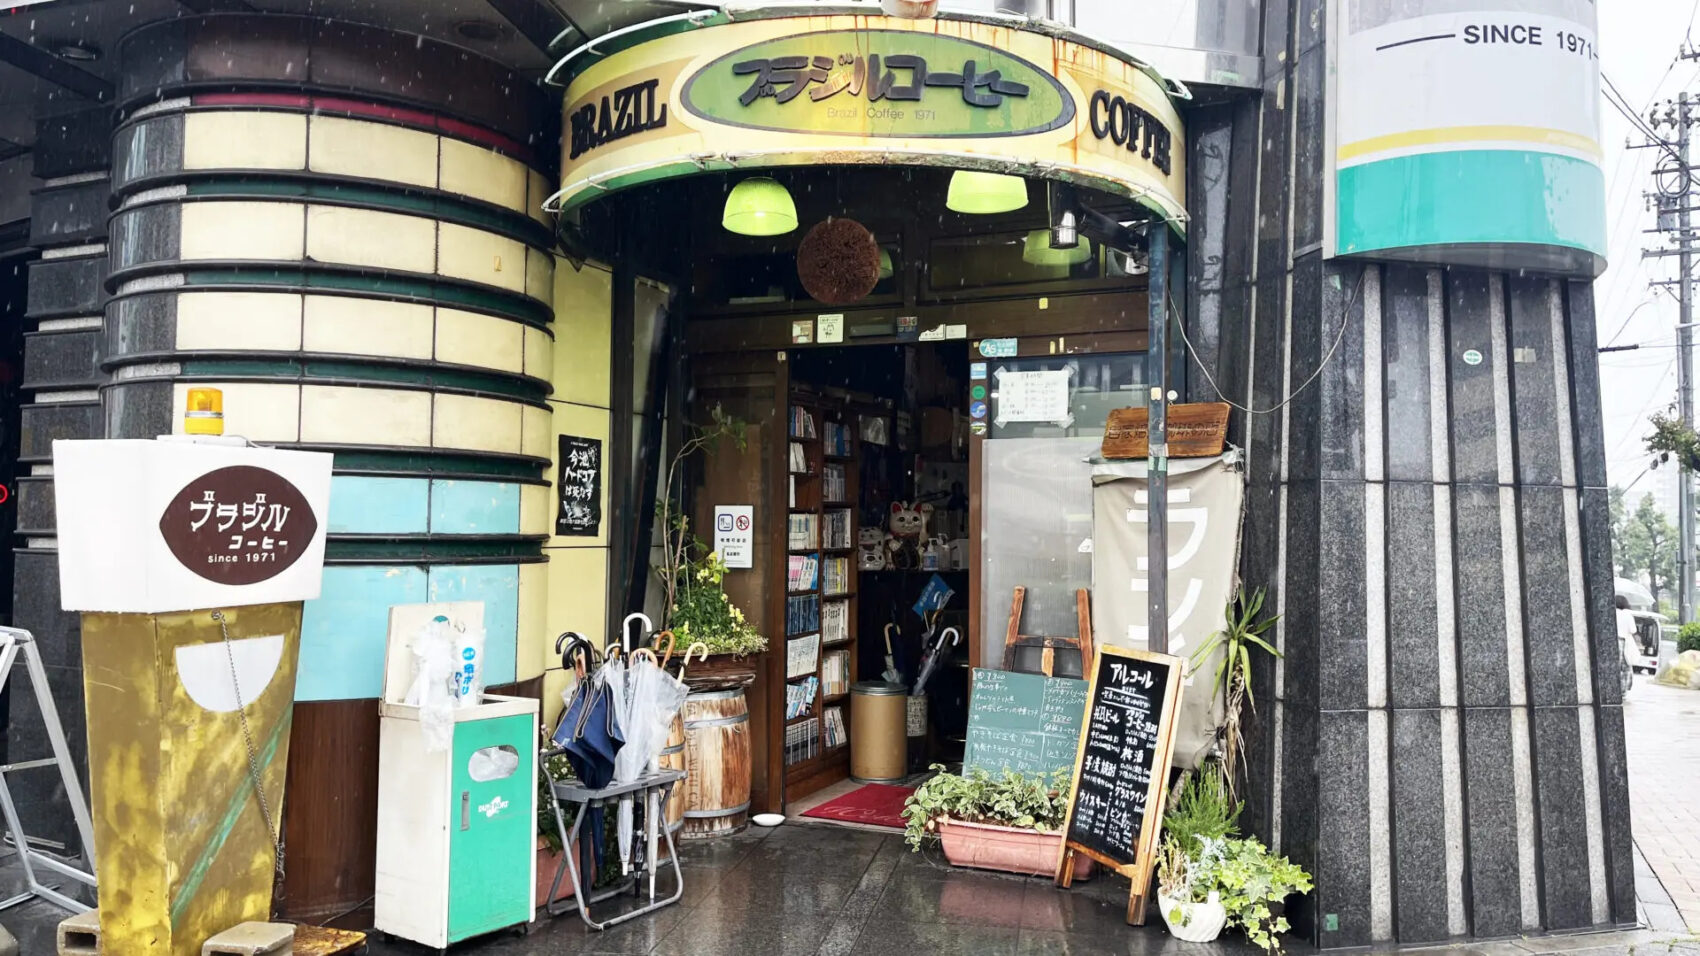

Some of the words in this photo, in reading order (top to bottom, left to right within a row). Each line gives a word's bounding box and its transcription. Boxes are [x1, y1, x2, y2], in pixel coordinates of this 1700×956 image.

[1463, 24, 1543, 46] SINCE
[732, 53, 1030, 108] ブラジルコーヒー
[570, 78, 667, 160] BRAZIL
[827, 107, 857, 118] Brazil
[866, 107, 904, 119] Coffee
[914, 109, 936, 120] 1971
[1090, 89, 1171, 176] COFFEE
[190, 490, 291, 532] ブラジル
[228, 535, 288, 550] コーヒー
[208, 555, 239, 563] since
[245, 553, 276, 562] 1971
[1110, 663, 1153, 689] アルコール
[1114, 786, 1148, 803] グラスワイン
